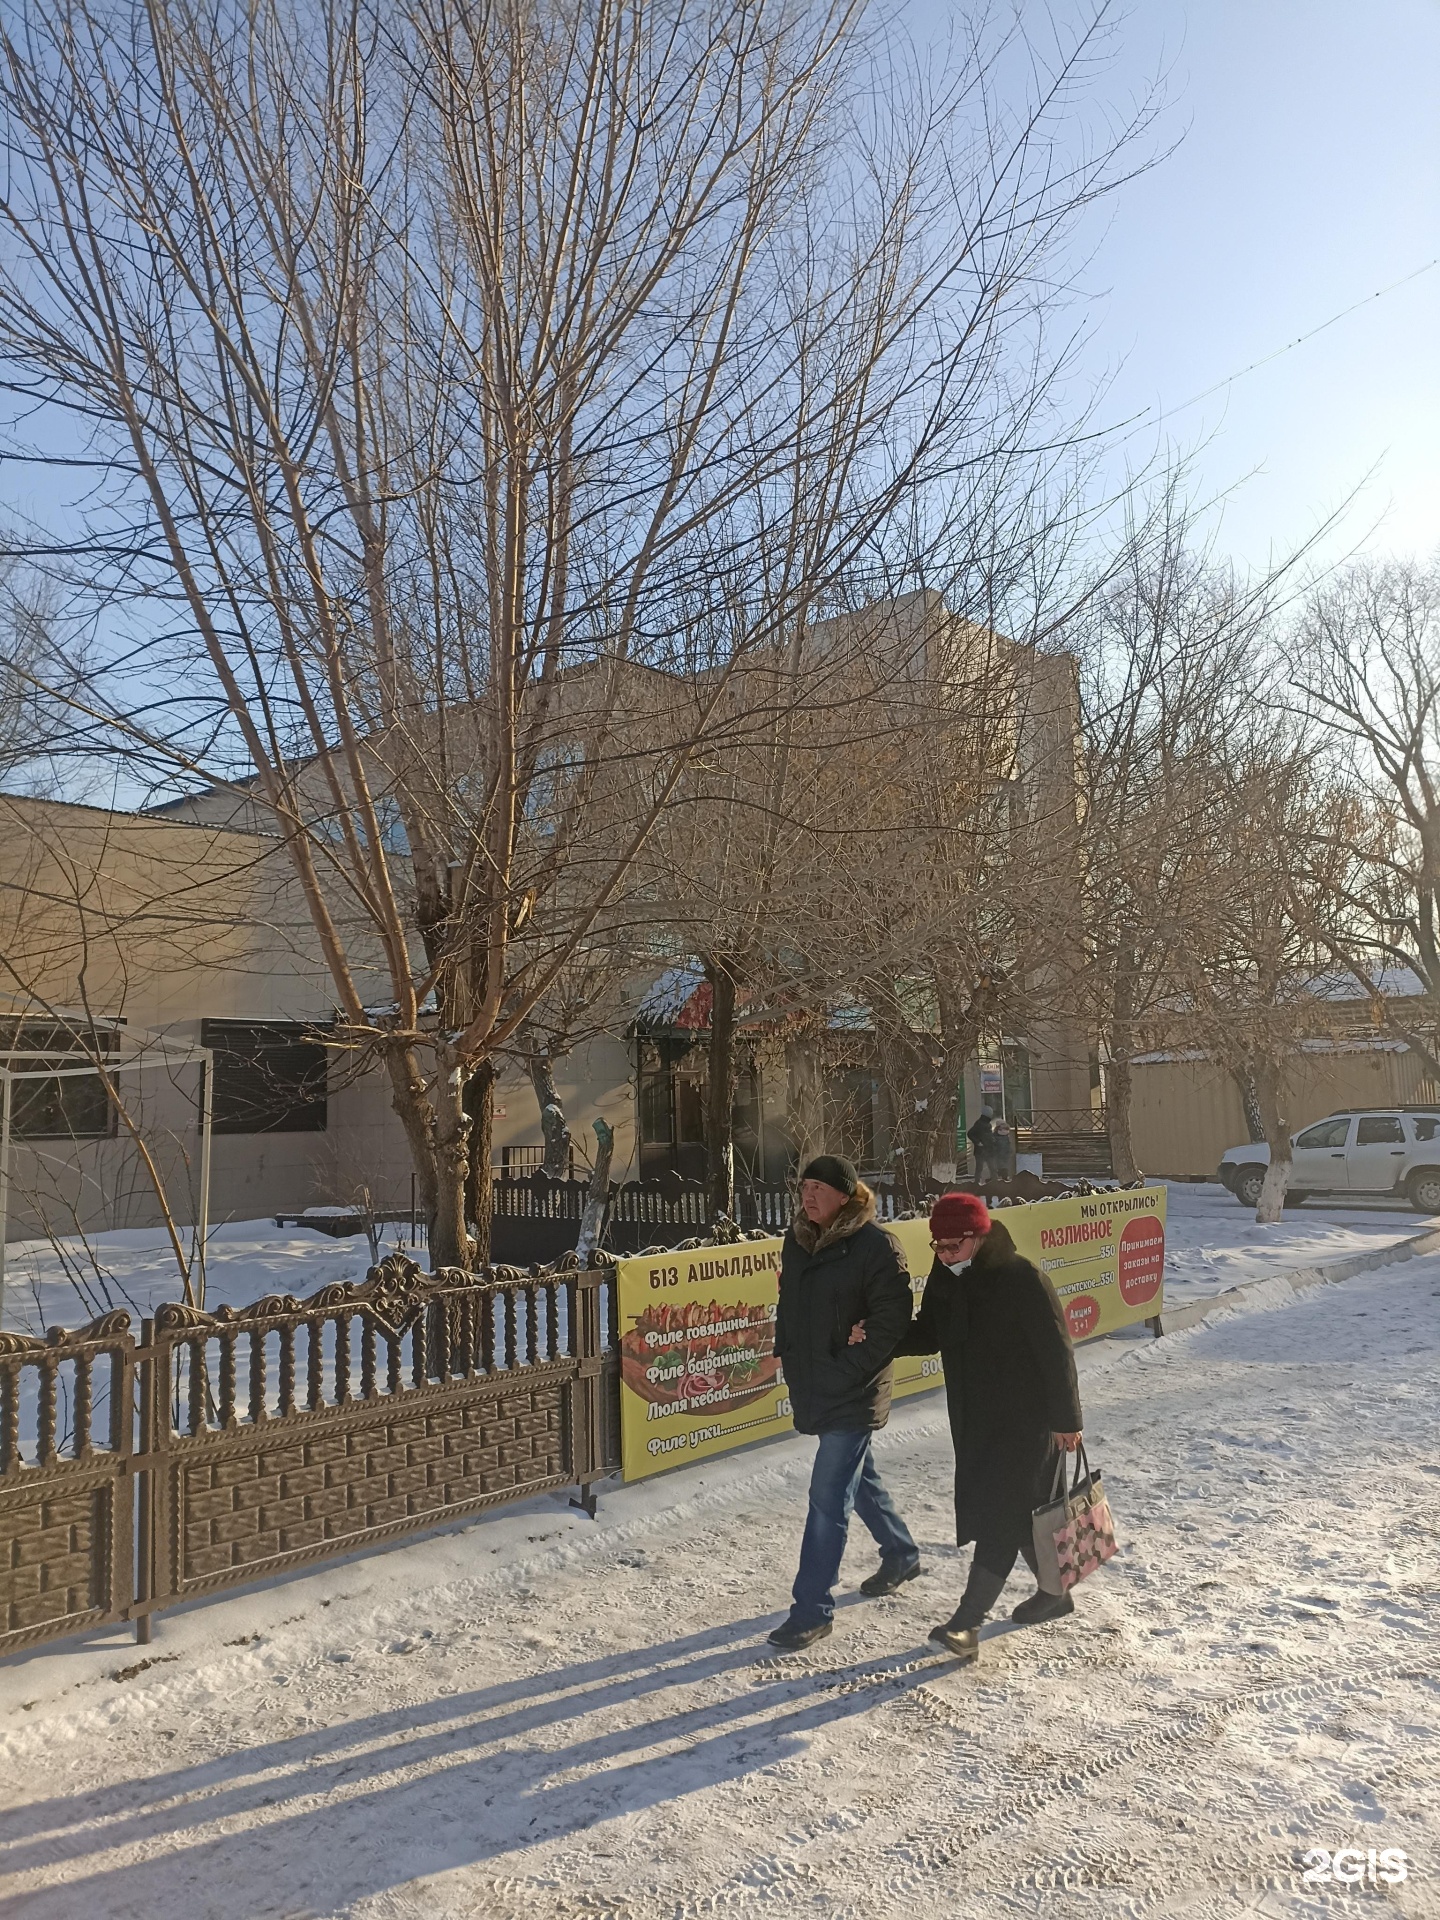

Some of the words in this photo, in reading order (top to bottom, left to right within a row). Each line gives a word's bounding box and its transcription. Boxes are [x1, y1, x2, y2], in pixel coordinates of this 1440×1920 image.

[1081, 1204, 1098, 1218] МЫ
[1100, 1195, 1159, 1215] ОТКРЫЛИСЬ!
[1040, 1220, 1113, 1250] РАЗЛИВНОЕ
[1100, 1244, 1116, 1259] 350
[1121, 1236, 1163, 1253] Принимаем
[1123, 1256, 1150, 1270] заказы
[1151, 1254, 1160, 1263] на
[1100, 1271, 1115, 1286] 350
[1125, 1273, 1158, 1290] доставку
[1069, 1306, 1092, 1320] Акция
[645, 1331, 684, 1348] Филе
[645, 1364, 685, 1384] Филе
[647, 1399, 688, 1421] Люля
[647, 1433, 687, 1456] Филе
